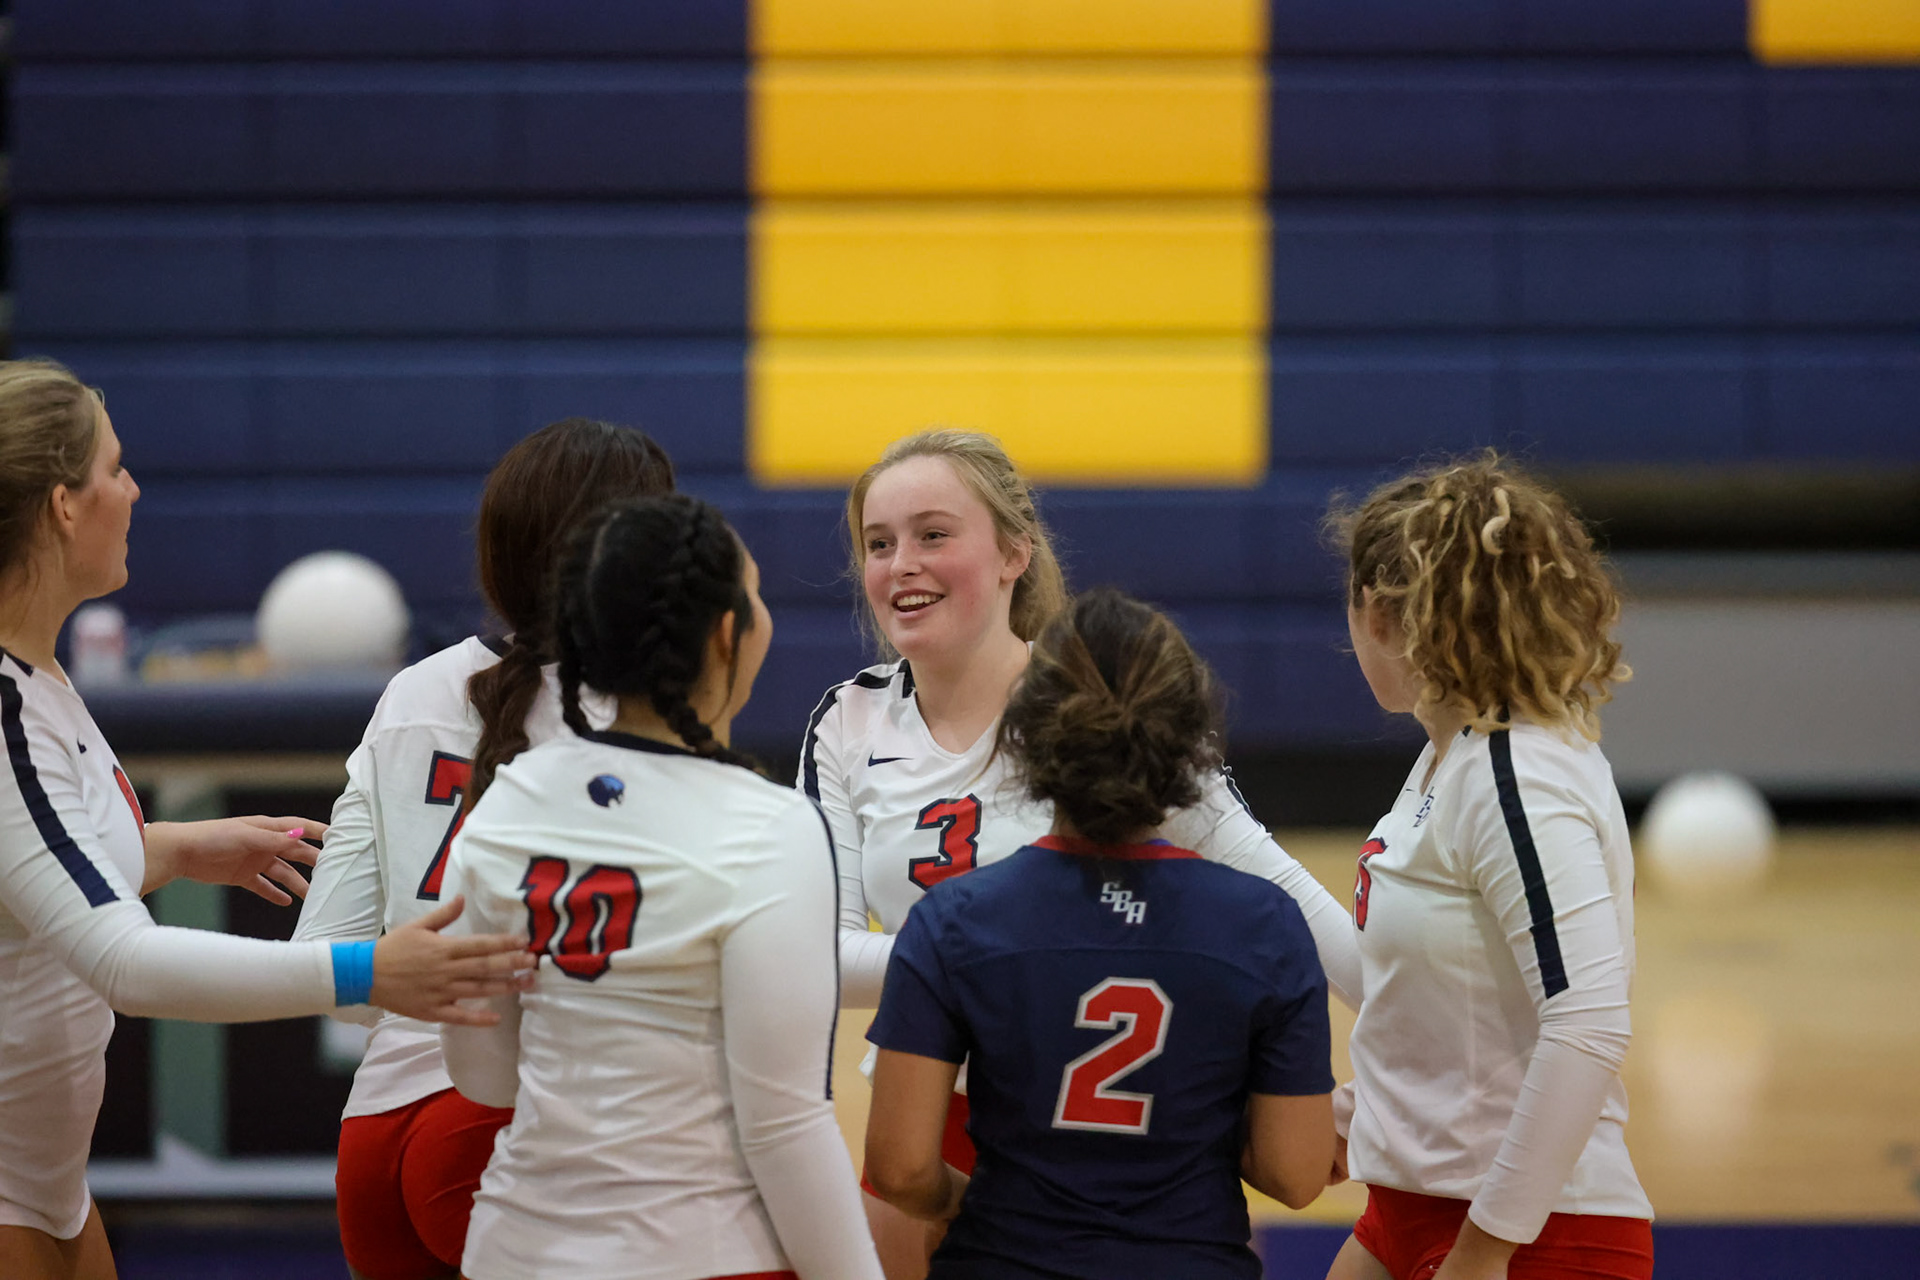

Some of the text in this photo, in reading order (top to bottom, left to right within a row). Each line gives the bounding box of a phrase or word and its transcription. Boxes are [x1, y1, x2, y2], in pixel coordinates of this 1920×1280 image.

[908, 793, 982, 891] 3
[517, 855, 643, 982] 10
[1100, 881, 1147, 924] SBA
[1051, 976, 1174, 1135] 2
